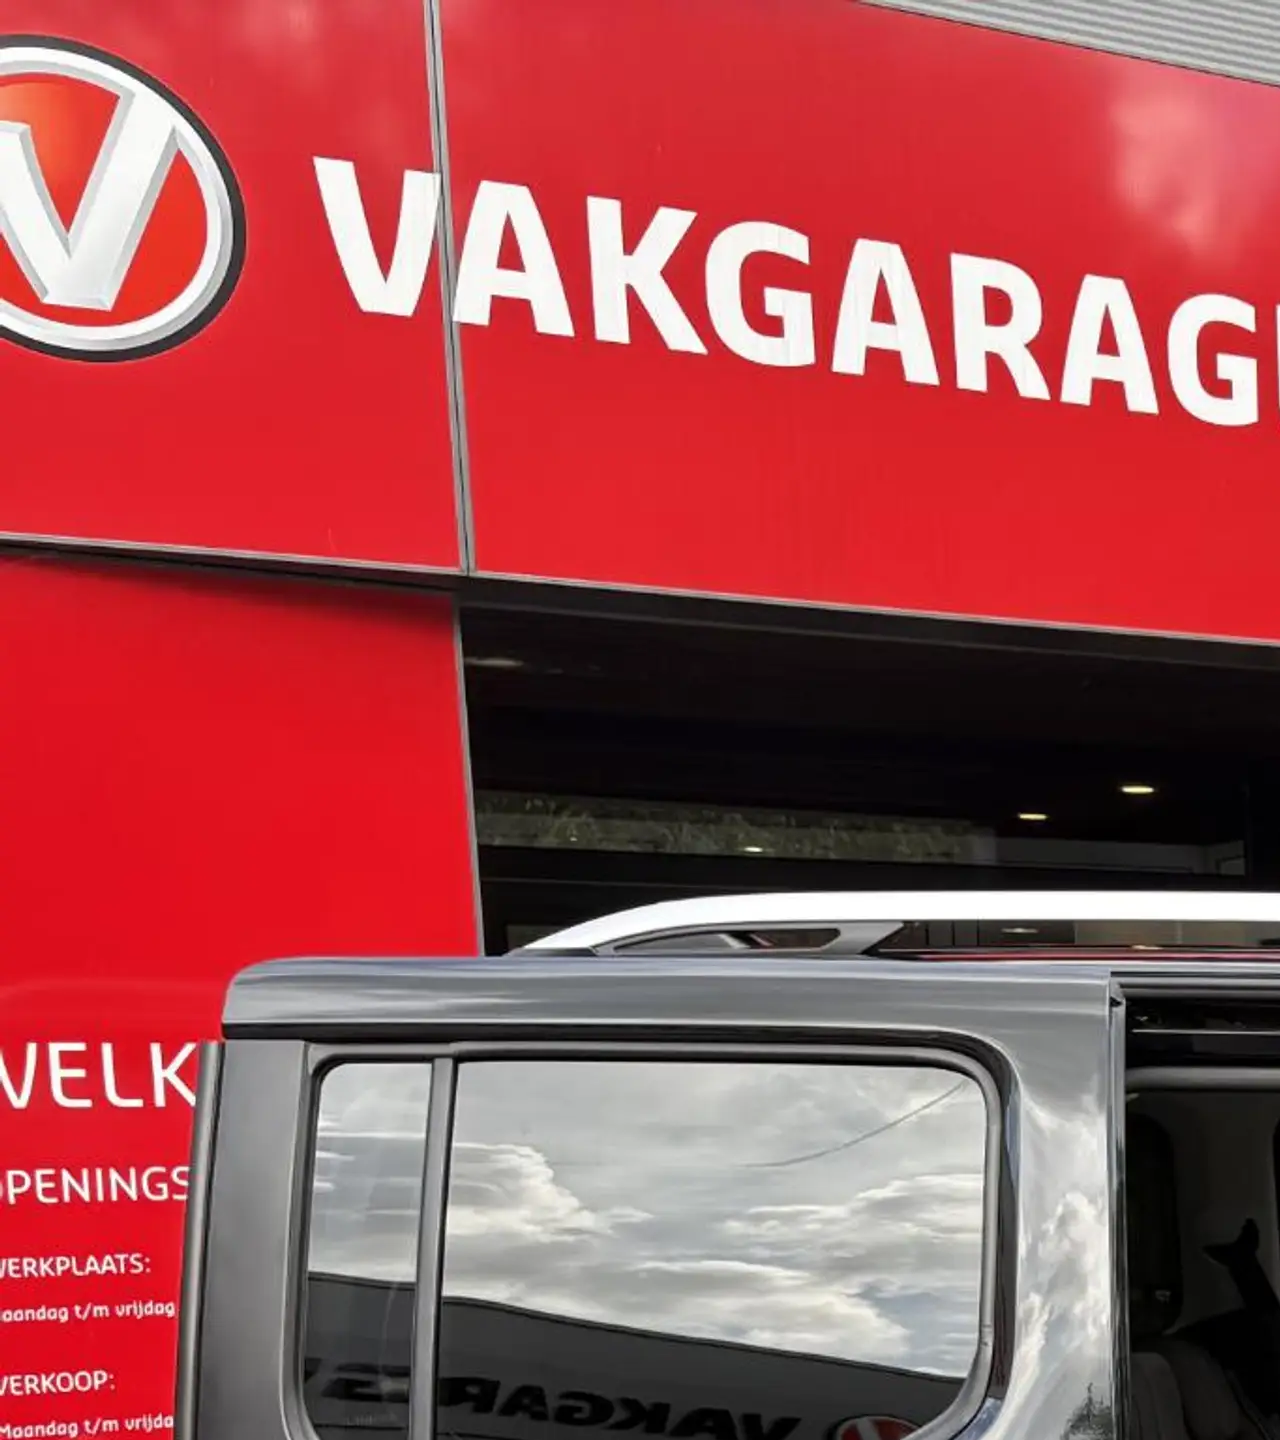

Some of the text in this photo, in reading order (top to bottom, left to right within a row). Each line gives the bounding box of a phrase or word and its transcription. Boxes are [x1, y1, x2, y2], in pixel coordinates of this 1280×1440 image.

[0, 1166, 190, 1205] PENINGS
[0, 1300, 175, 1323] aandag t/m vrijdag
[84, 1417, 120, 1437] t/m
